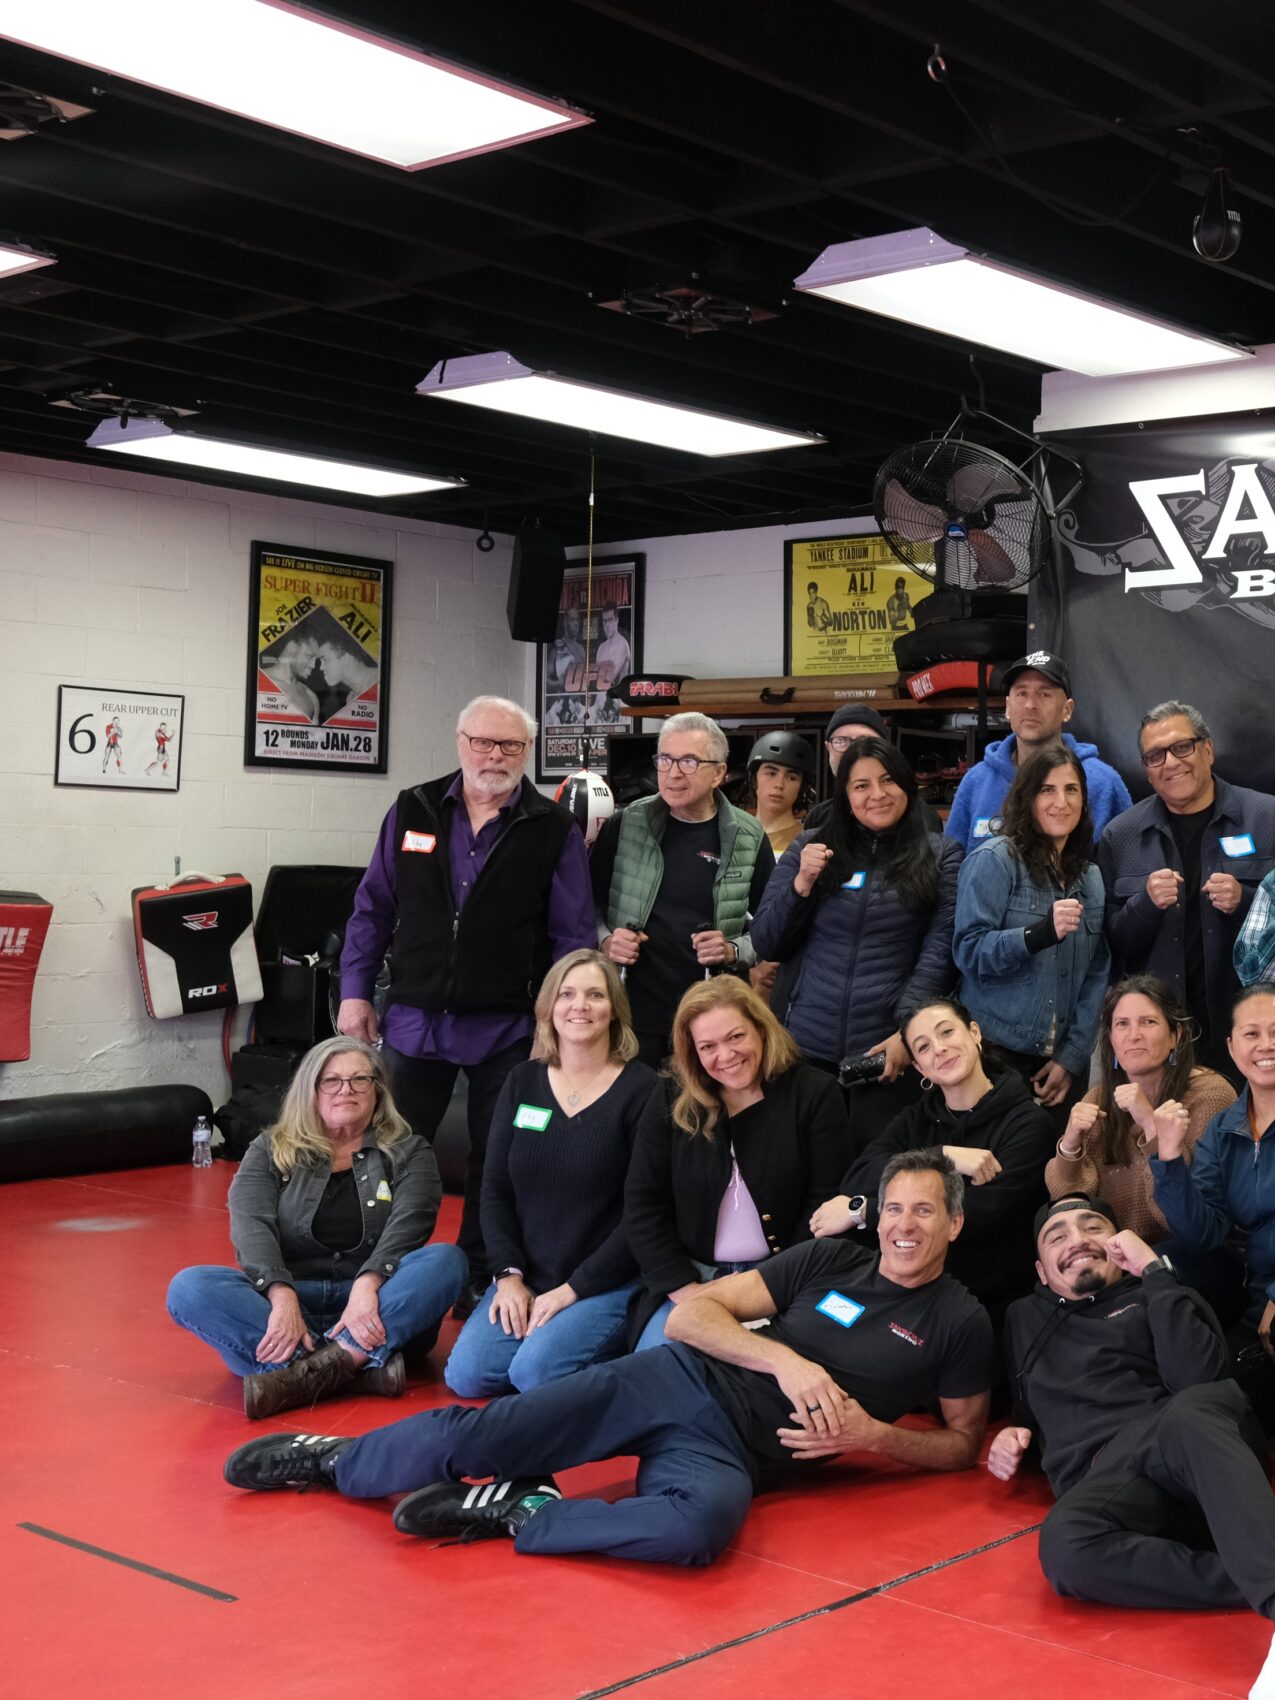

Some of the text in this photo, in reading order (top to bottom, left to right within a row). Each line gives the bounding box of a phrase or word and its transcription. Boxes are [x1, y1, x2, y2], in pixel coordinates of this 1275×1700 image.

[282, 558, 295, 568] LIVE
[809, 548, 834, 562] YANKEE
[839, 547, 869, 560] STADIUM
[264, 575, 377, 604] SUPER FIGHT II
[848, 572, 874, 592] ALI
[261, 596, 317, 643] FRAZIER
[339, 610, 373, 643] ALI
[832, 610, 888, 632] NORTON
[565, 660, 615, 692] UFC
[102, 703, 179, 717] REAR UPPER CUT
[351, 710, 374, 718] RADIO
[68, 713, 97, 754] 6
[263, 729, 372, 753] 12 ROUNDS JAN.28
[290, 740, 318, 750] MONDAY
[547, 744, 576, 753] DEC.10
[578, 738, 605, 749] LVE
[592, 788, 609, 797] TITLE
[891, 1328, 917, 1346] BOXING
